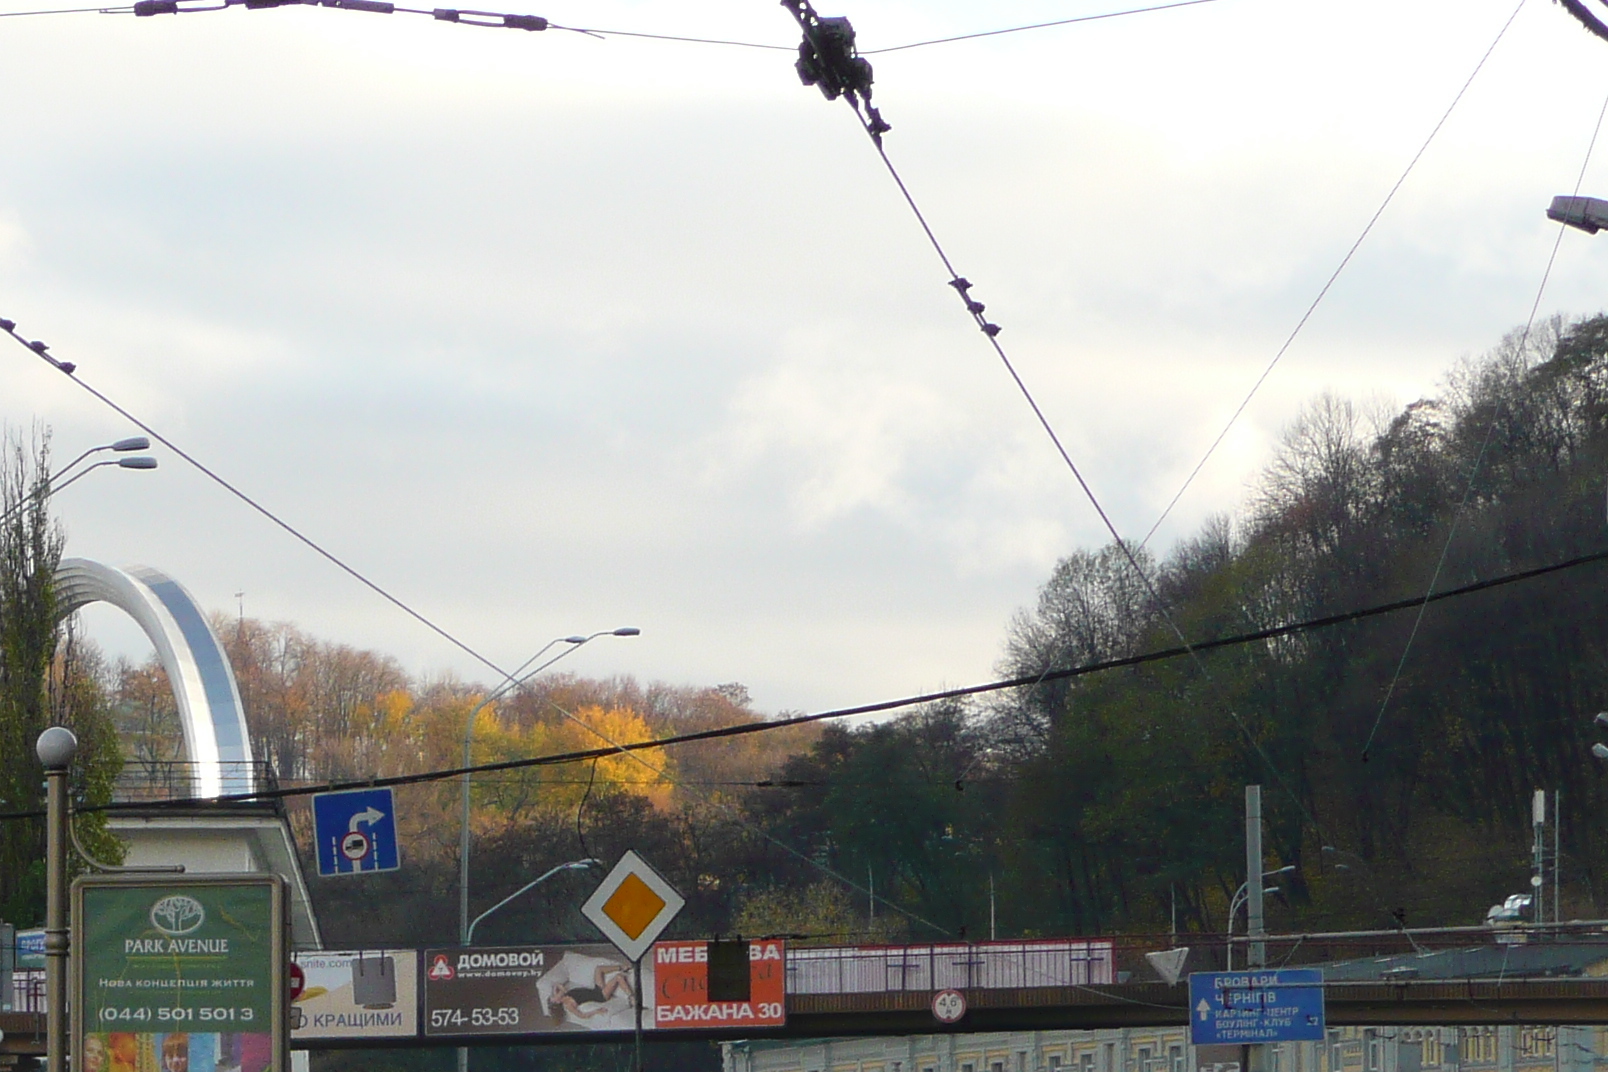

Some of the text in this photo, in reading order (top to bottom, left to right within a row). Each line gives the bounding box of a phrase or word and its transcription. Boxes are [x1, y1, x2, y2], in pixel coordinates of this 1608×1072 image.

[125, 939, 229, 953] PARK AVENUE
[457, 949, 544, 970] ДОМОВОЙ
[99, 1007, 254, 1022] (044) 501 501 3
[657, 1002, 782, 1021] БАЖАНА 30
[314, 1012, 402, 1028] КРАЩИМИ
